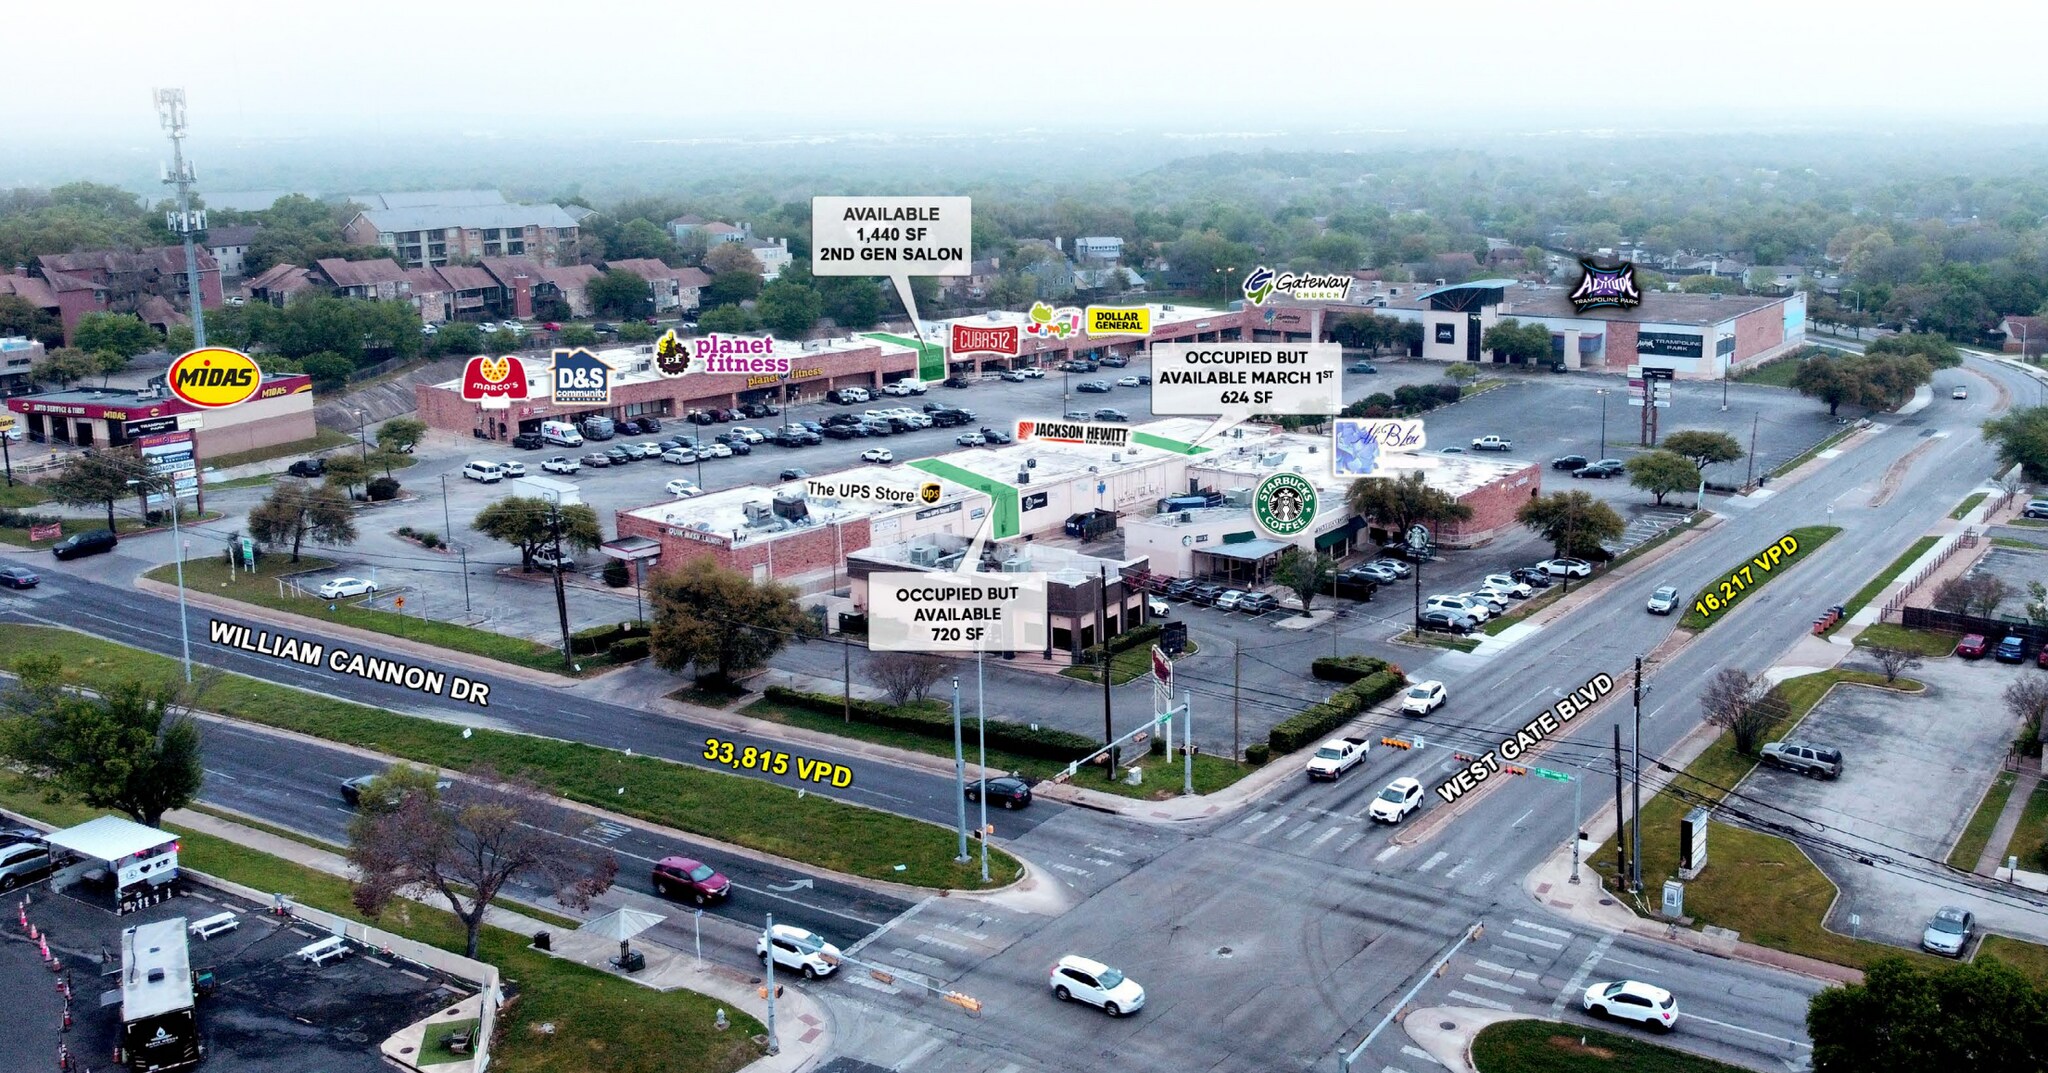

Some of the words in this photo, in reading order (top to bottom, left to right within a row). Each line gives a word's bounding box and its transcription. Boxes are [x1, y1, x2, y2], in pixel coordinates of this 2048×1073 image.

[1655, 338, 1702, 347] TRAMPOLINE
[747, 373, 779, 388] planet
[790, 367, 824, 379] fitness
[34, 404, 46, 412] AUTO
[47, 405, 67, 414] SERVICE
[103, 410, 127, 420] MIDAS
[543, 424, 560, 436] FedEx
